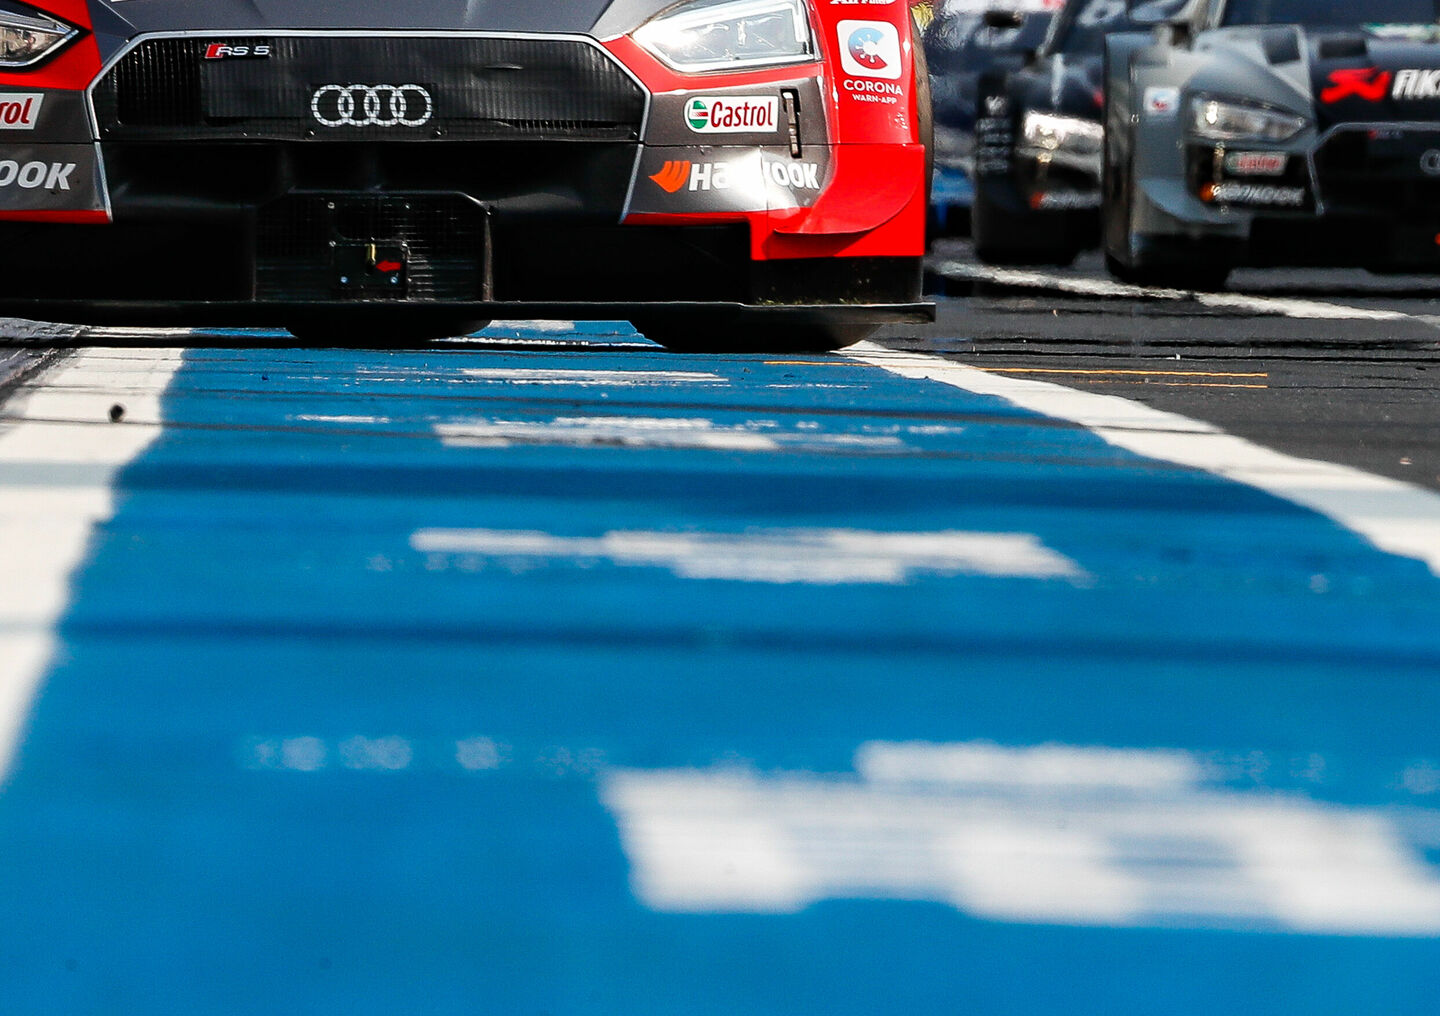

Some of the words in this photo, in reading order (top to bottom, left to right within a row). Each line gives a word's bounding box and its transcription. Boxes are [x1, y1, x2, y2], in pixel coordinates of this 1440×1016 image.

[215, 45, 250, 56] RS
[253, 45, 271, 56] 5
[843, 78, 904, 96] CORONA
[852, 93, 898, 105] WARN-APP
[710, 100, 774, 128] Castrol
